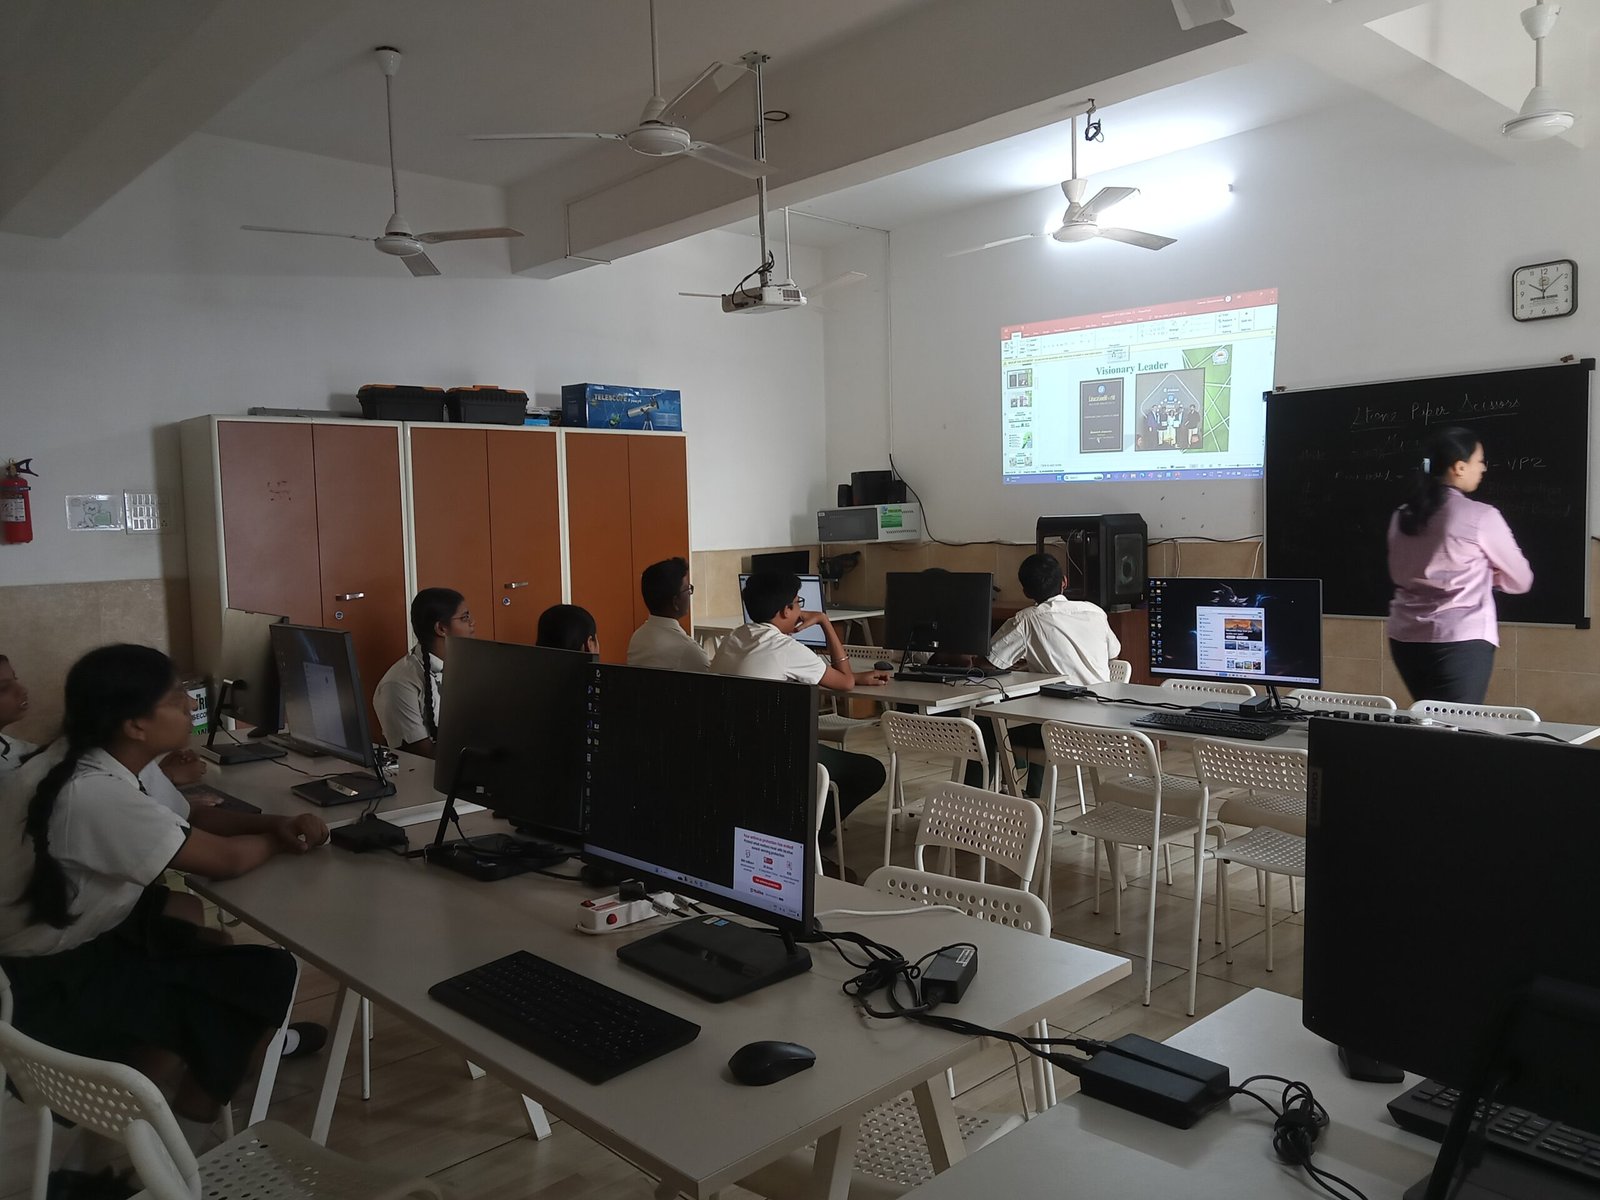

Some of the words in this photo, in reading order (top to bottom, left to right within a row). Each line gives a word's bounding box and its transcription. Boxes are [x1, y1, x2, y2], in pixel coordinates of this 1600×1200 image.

[1096, 365, 1135, 376] Visionary
[1137, 361, 1168, 372] Leader
[593, 393, 627, 402] TELESCOPE
